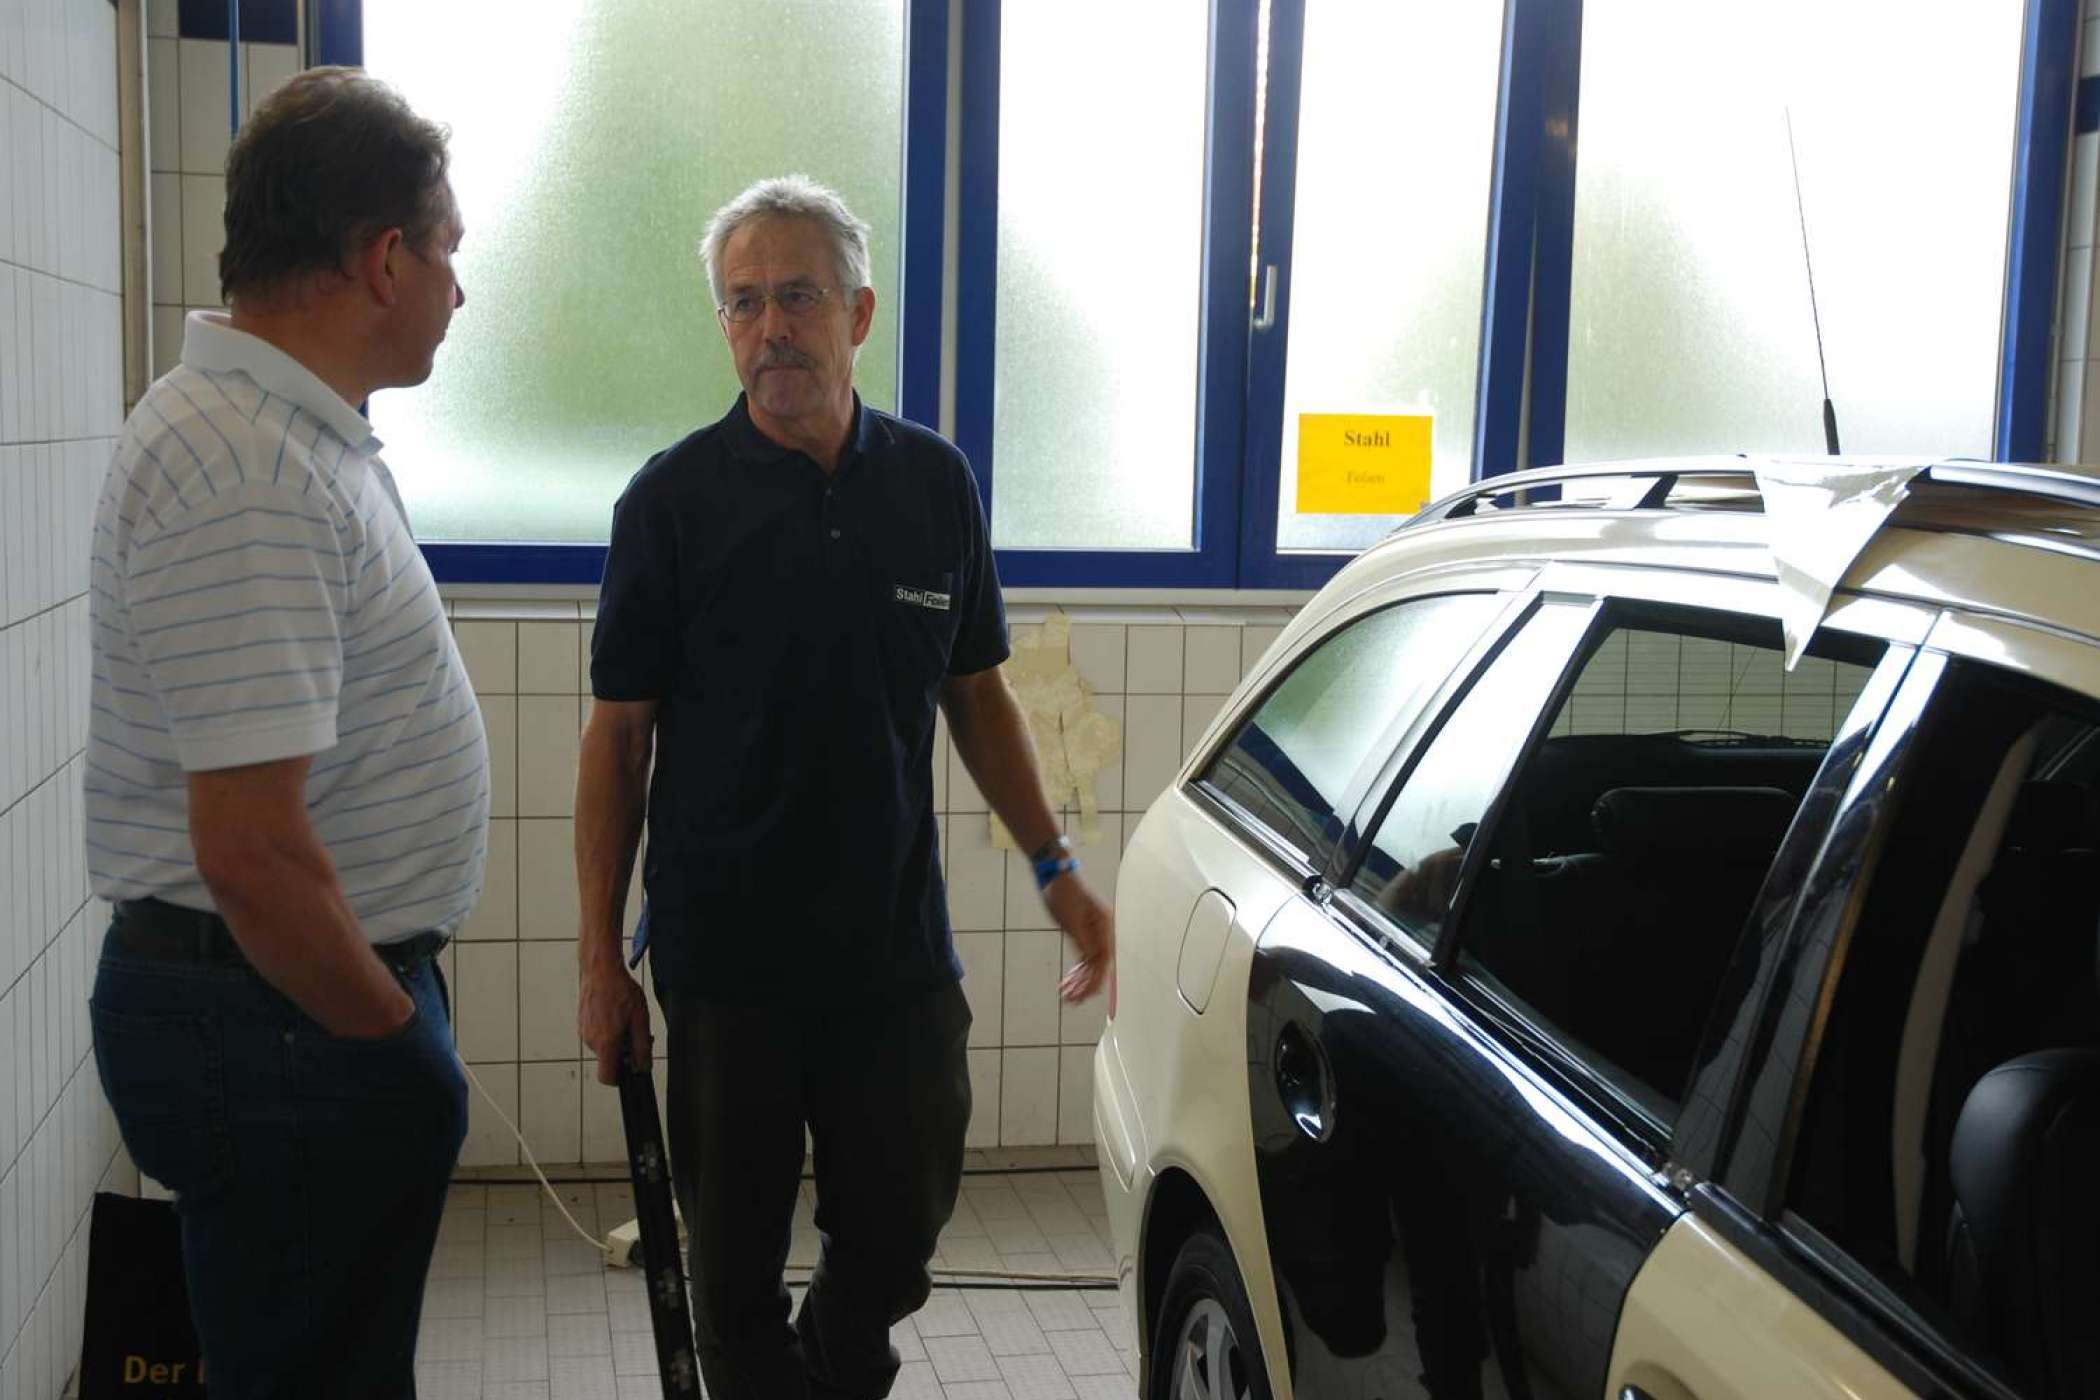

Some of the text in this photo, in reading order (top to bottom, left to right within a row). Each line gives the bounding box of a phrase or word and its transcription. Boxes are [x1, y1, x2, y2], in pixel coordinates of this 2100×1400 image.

[1343, 431, 1391, 448] Stahl
[896, 587, 924, 603] Stahl
[124, 1355, 186, 1384] Der
